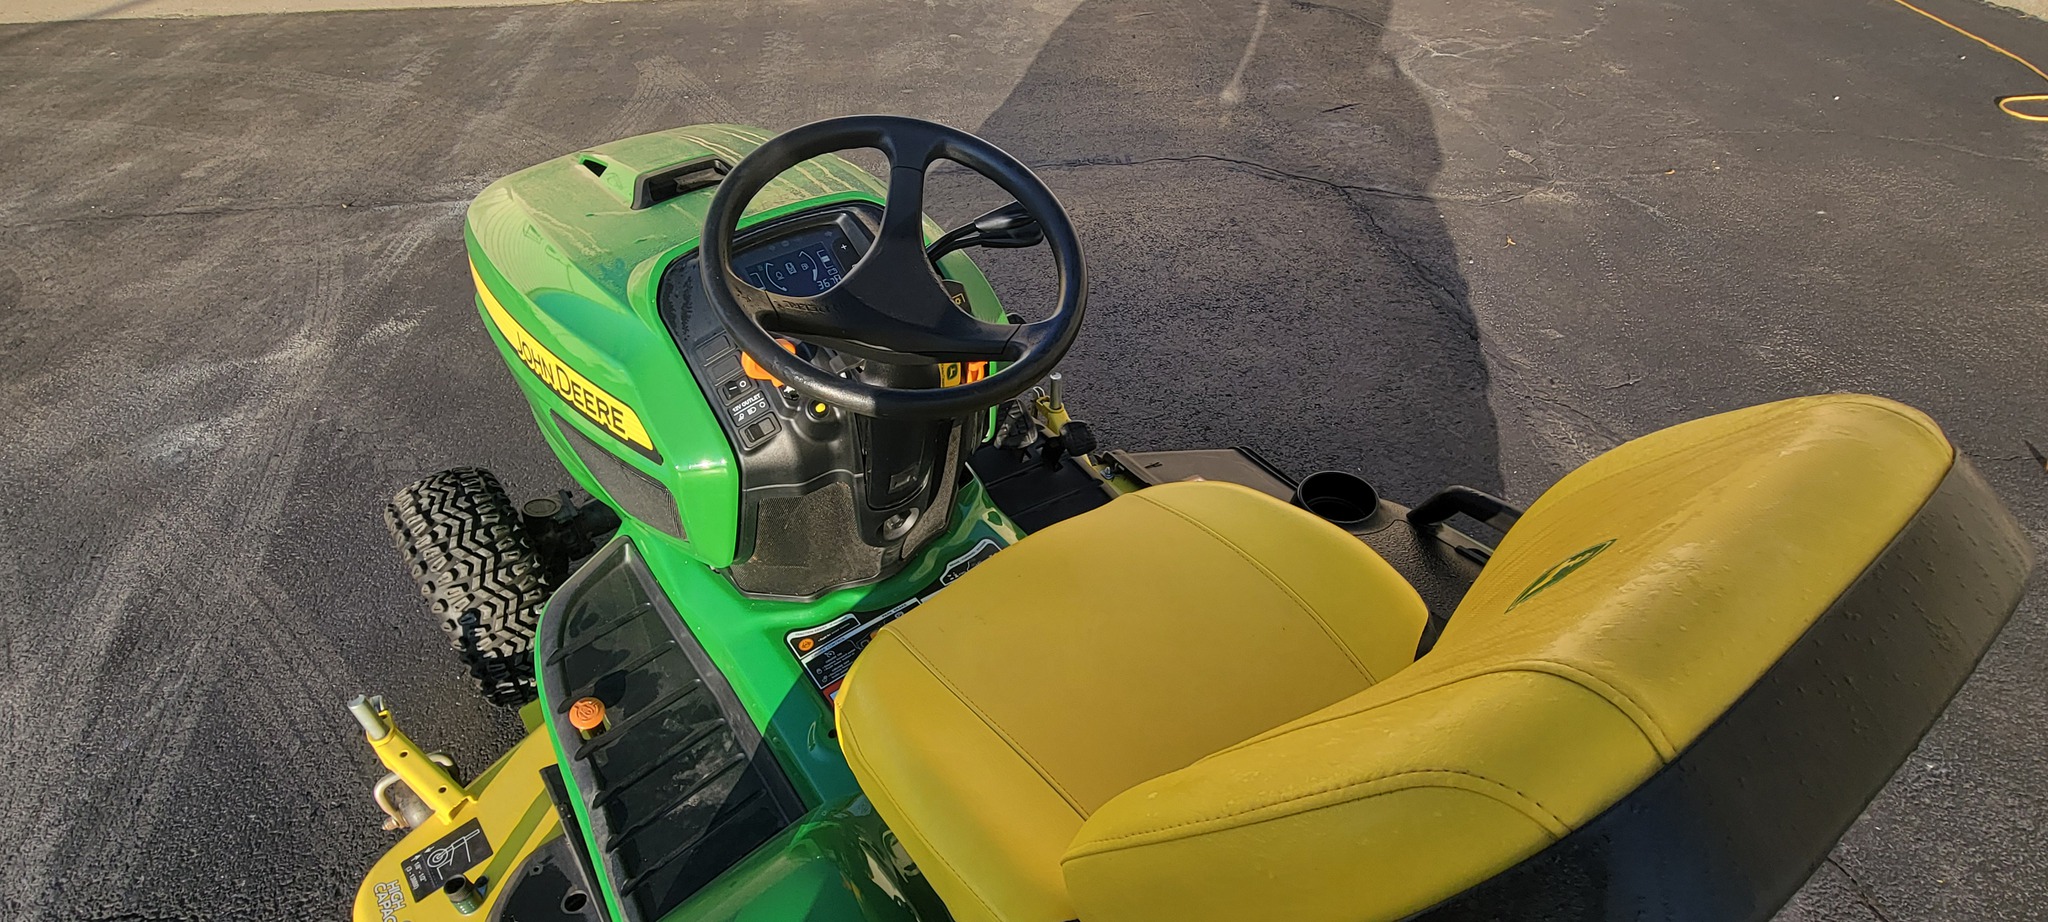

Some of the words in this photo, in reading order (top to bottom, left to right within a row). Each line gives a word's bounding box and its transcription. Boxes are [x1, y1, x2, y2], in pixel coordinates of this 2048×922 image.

[516, 331, 556, 386] JOHN
[556, 364, 627, 435] DEERE
[732, 403, 742, 413] 12V
[741, 392, 761, 409] OUTLET
[386, 879, 406, 911] HIGH
